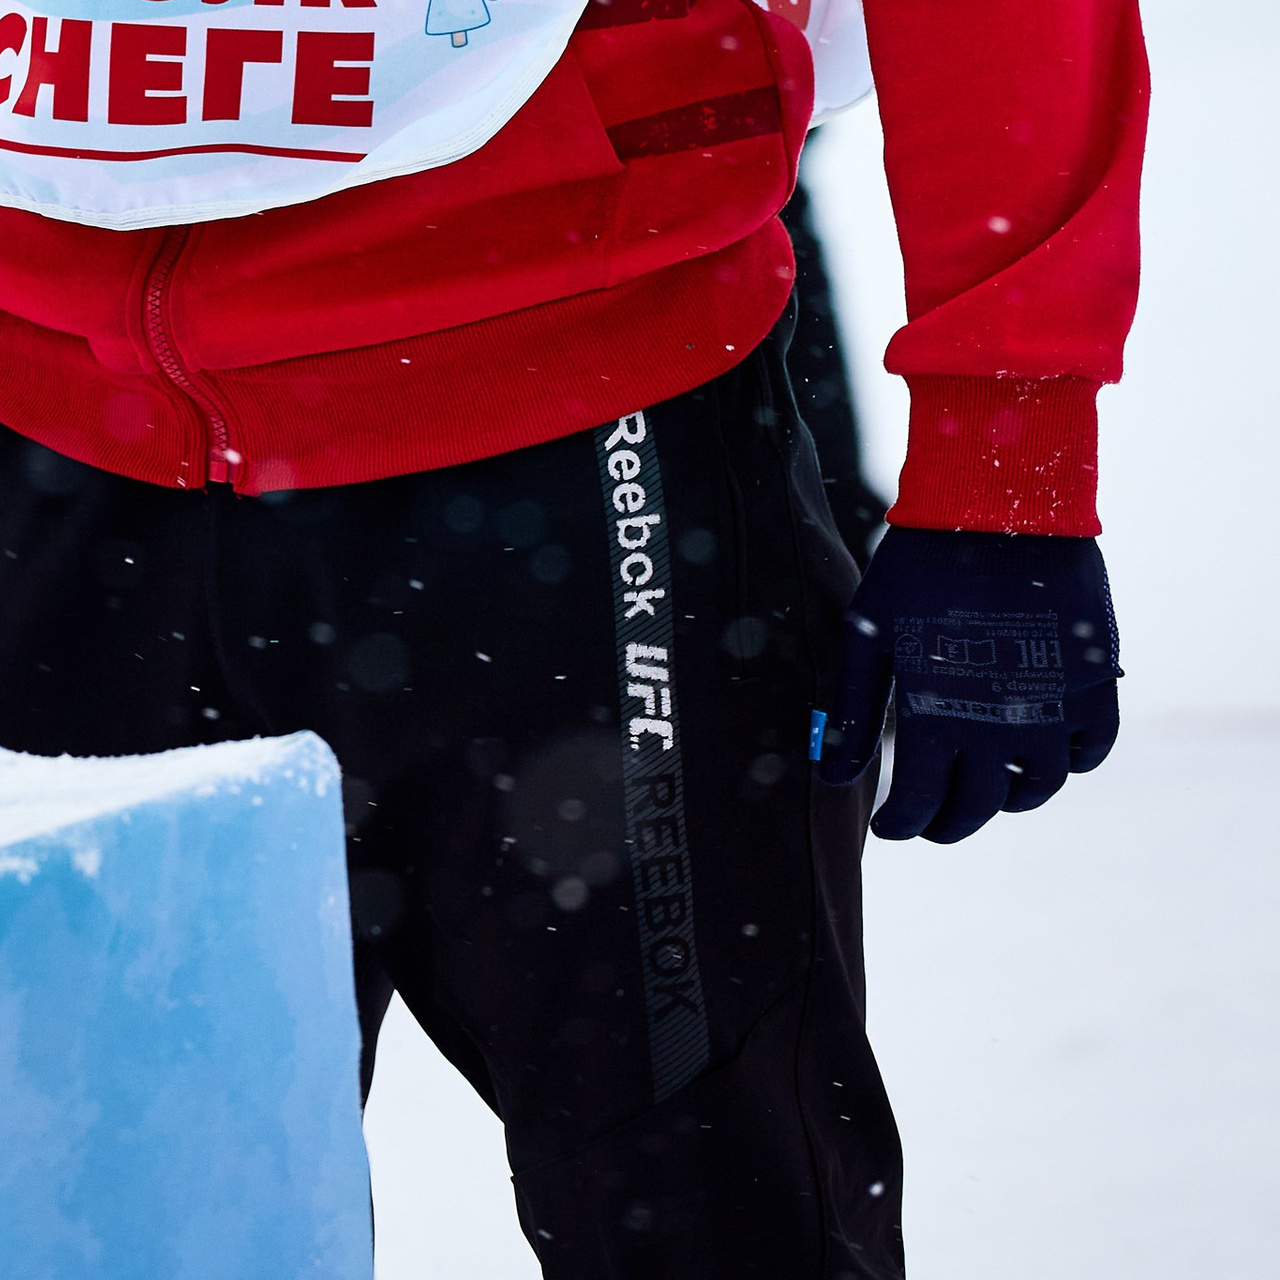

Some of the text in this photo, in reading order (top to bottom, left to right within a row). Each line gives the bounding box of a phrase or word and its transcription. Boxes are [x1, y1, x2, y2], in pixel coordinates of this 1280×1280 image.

[604, 409, 666, 621] Reebok
[625, 641, 674, 751] UFC
[631, 773, 701, 1023] REEBOK
